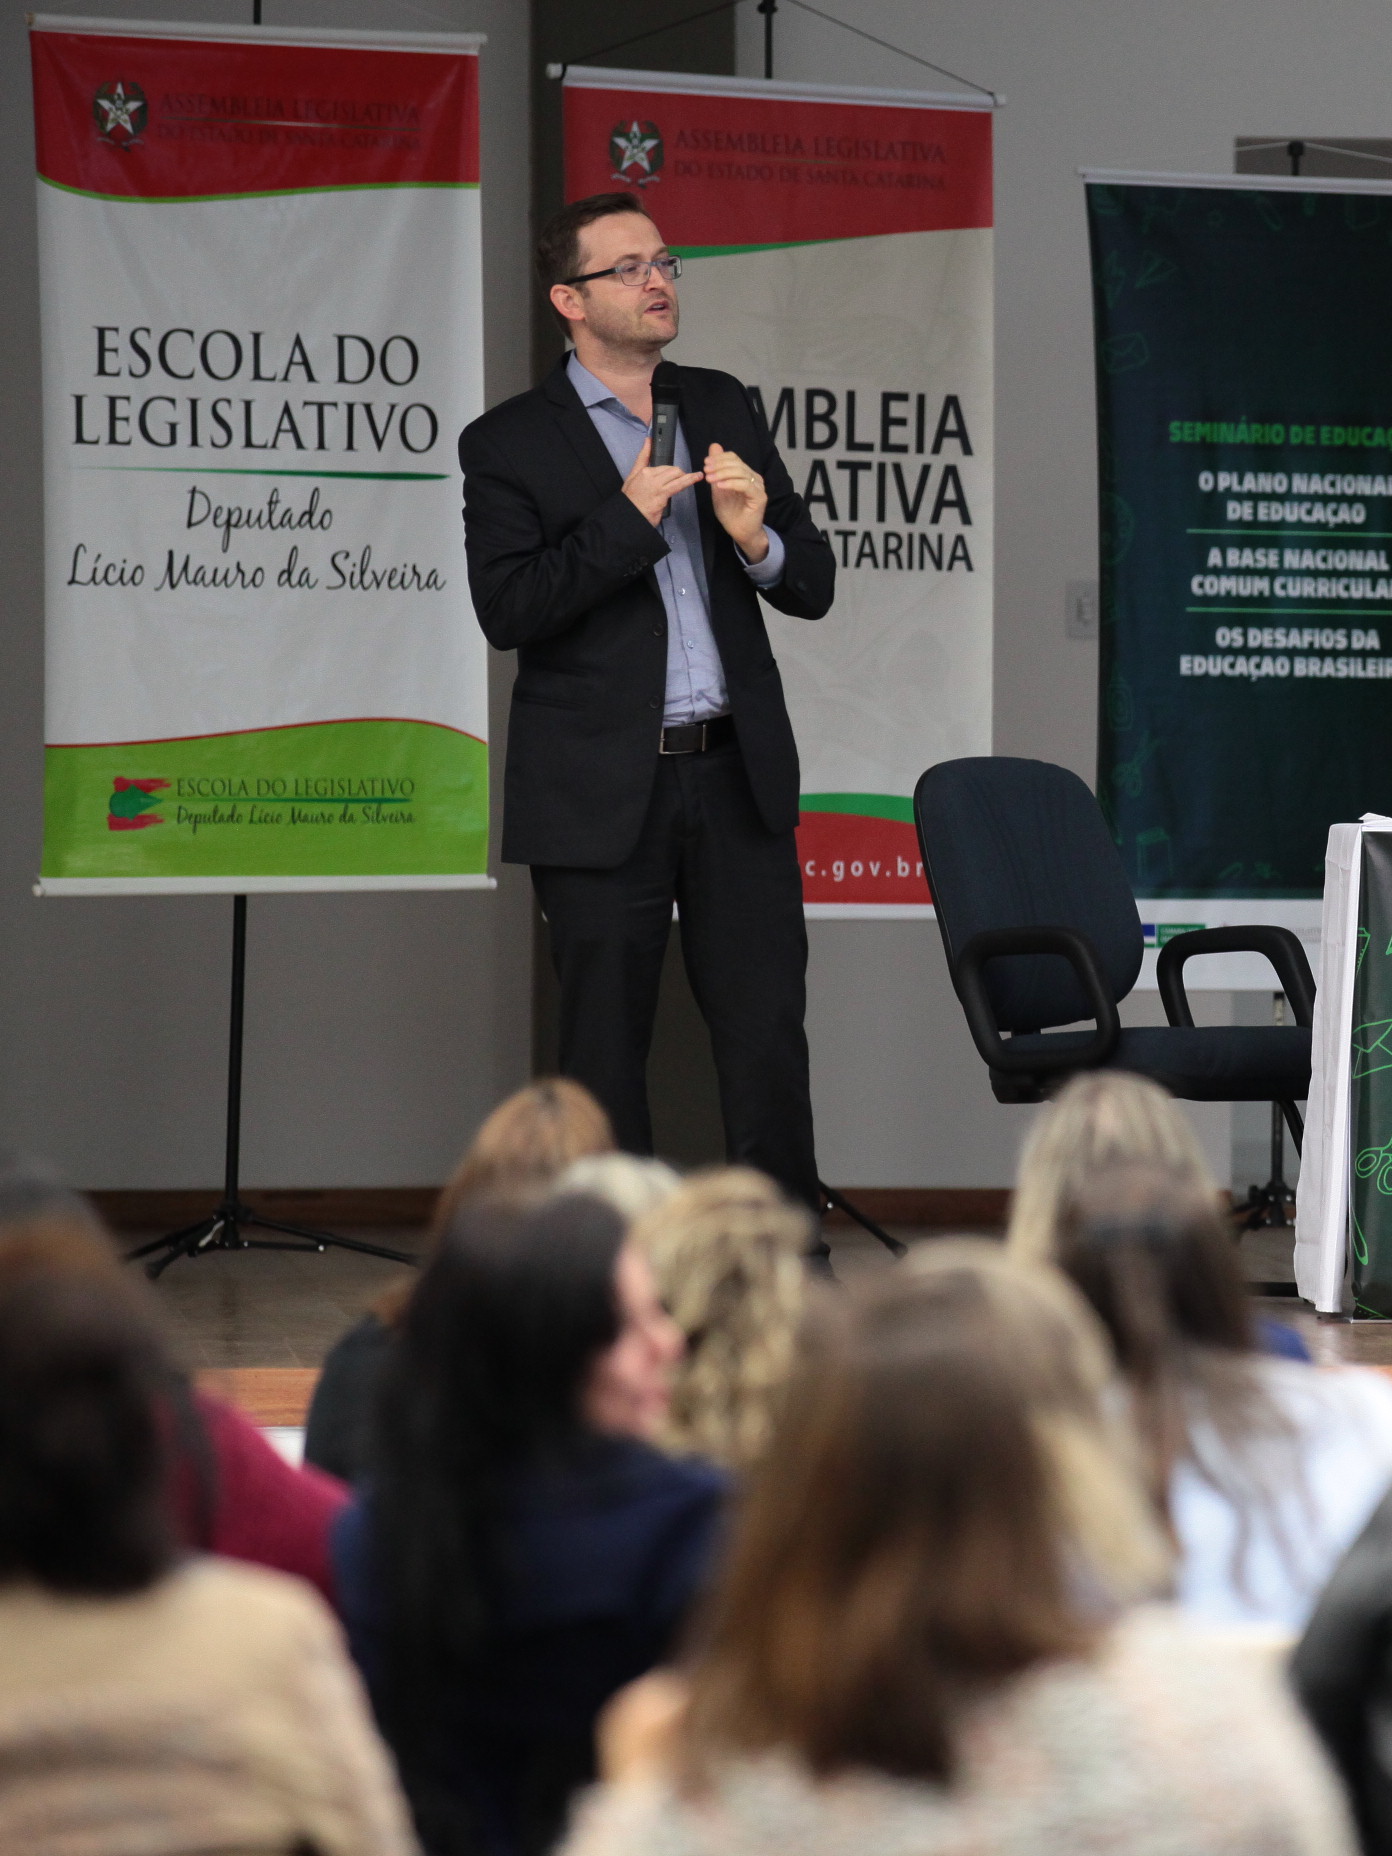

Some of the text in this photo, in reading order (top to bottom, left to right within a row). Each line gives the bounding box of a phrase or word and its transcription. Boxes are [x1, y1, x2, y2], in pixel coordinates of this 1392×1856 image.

[673, 129, 947, 164] ASSEMBLEIA LEGISLATIVA
[673, 159, 947, 191] DO ESTADO DE SANTA CATARINA
[93, 326, 420, 387] ESCOLA DO
[70, 393, 438, 454] LEGISLATIVO
[1168, 415, 1286, 446] SEMINÁRIO
[1289, 424, 1316, 445] DE
[1198, 470, 1215, 492] O
[1217, 471, 1289, 494] PLANO
[185, 485, 333, 553] Deputado
[1226, 499, 1254, 522] DE
[819, 529, 975, 573] TARINA
[1207, 547, 1391, 572] A BASE NACIONAL
[67, 543, 448, 592] Lício Mauro da Silveira
[1190, 574, 1271, 597] COMUM
[1214, 626, 1381, 651] OS DESAFIOS DA
[176, 777, 416, 798] ESCOLA DO LEGISLATIVO
[176, 803, 243, 835] Deputado
[339, 803, 357, 825] da
[361, 803, 416, 825] Silveira
